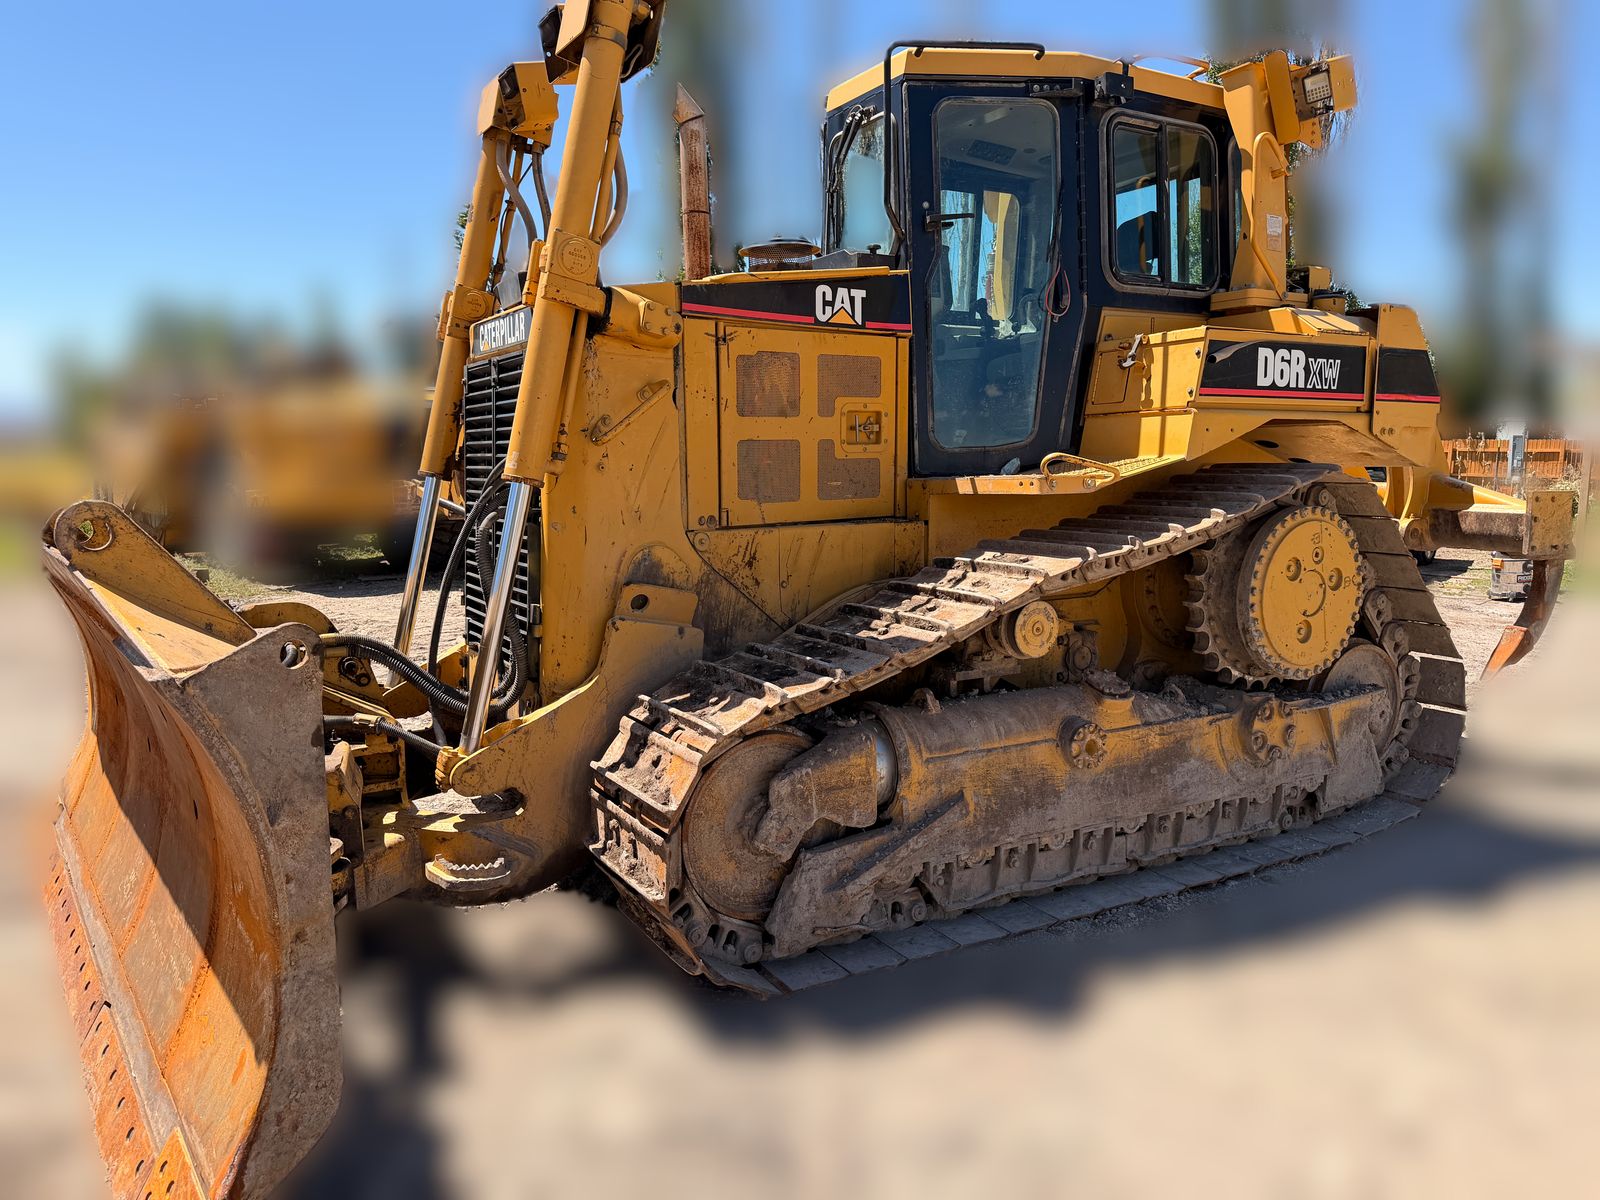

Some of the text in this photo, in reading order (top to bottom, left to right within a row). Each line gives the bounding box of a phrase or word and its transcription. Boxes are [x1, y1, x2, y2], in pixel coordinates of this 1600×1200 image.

[815, 284, 867, 326] CAT
[479, 311, 525, 352] CATERPILLAR
[1256, 347, 1306, 389] D6R
